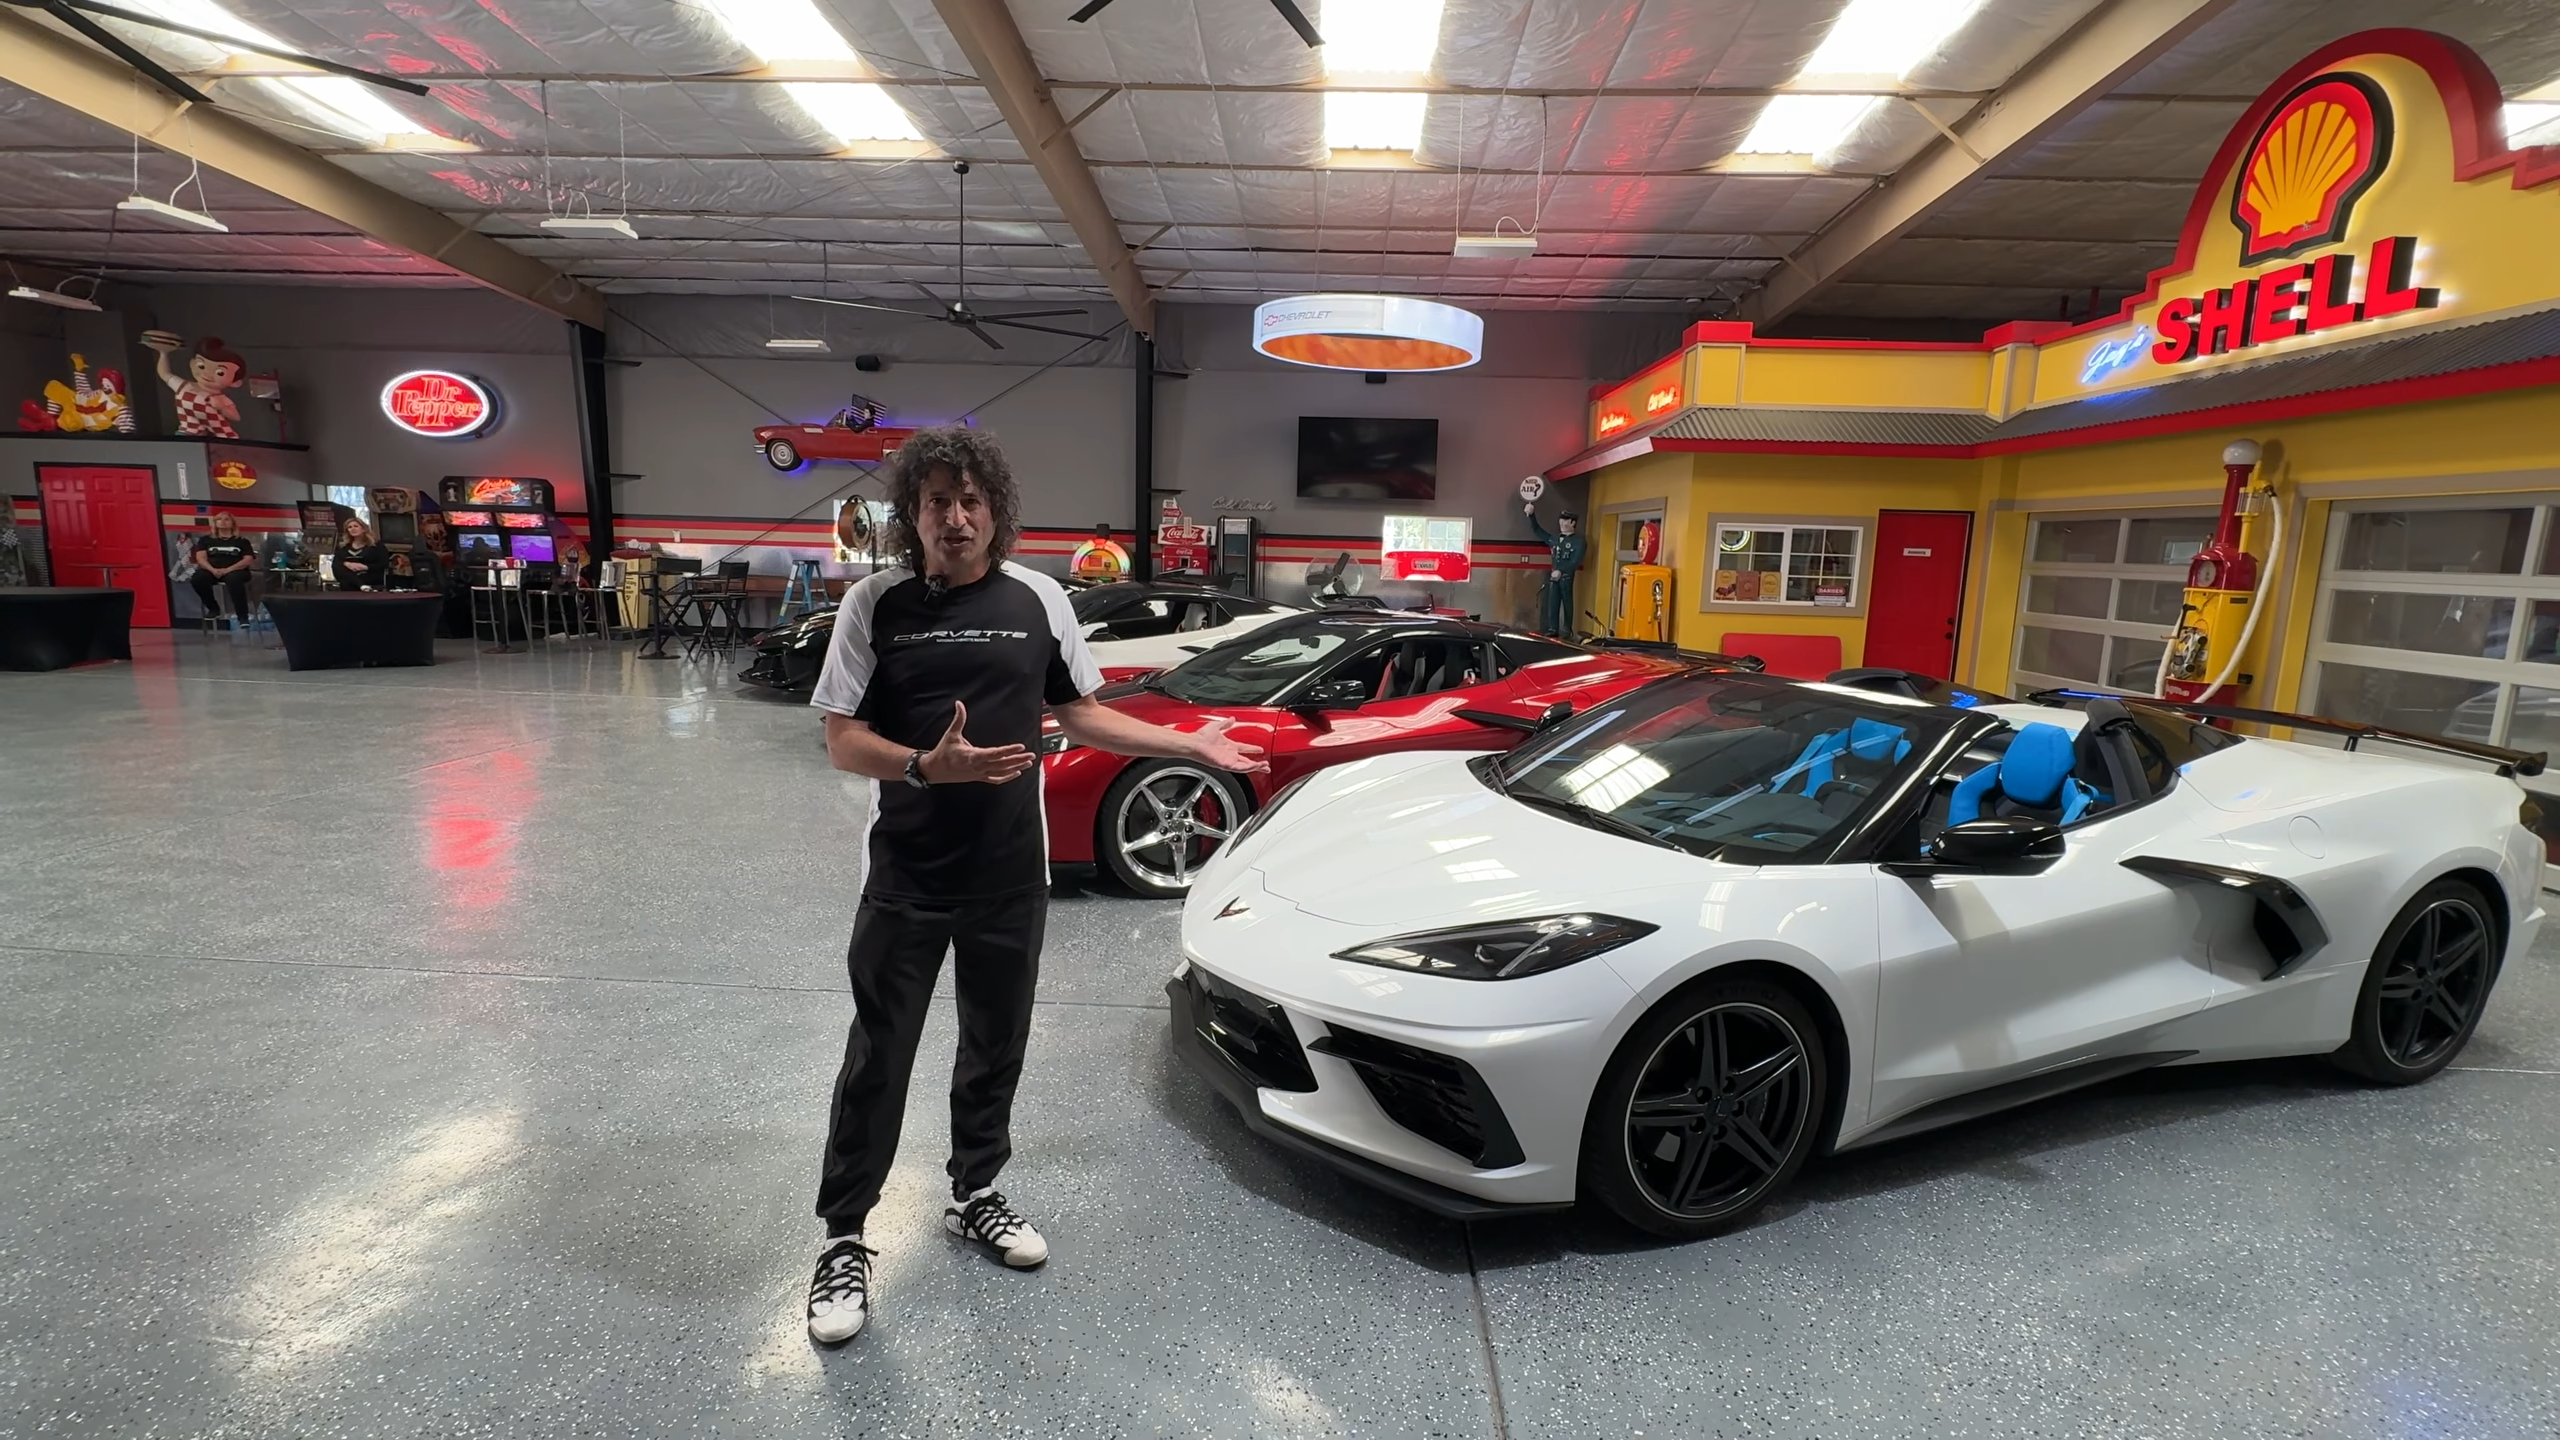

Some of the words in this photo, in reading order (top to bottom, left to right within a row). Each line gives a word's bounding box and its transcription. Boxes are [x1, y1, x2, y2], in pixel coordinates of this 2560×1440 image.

[2152, 236, 2438, 365] SHELL
[1278, 310, 1332, 323] CHEVROLET
[421, 377, 463, 401] Dr
[394, 389, 481, 427] Pepper
[1212, 496, 1241, 510] Cold
[893, 629, 1029, 641] CORVETTE
